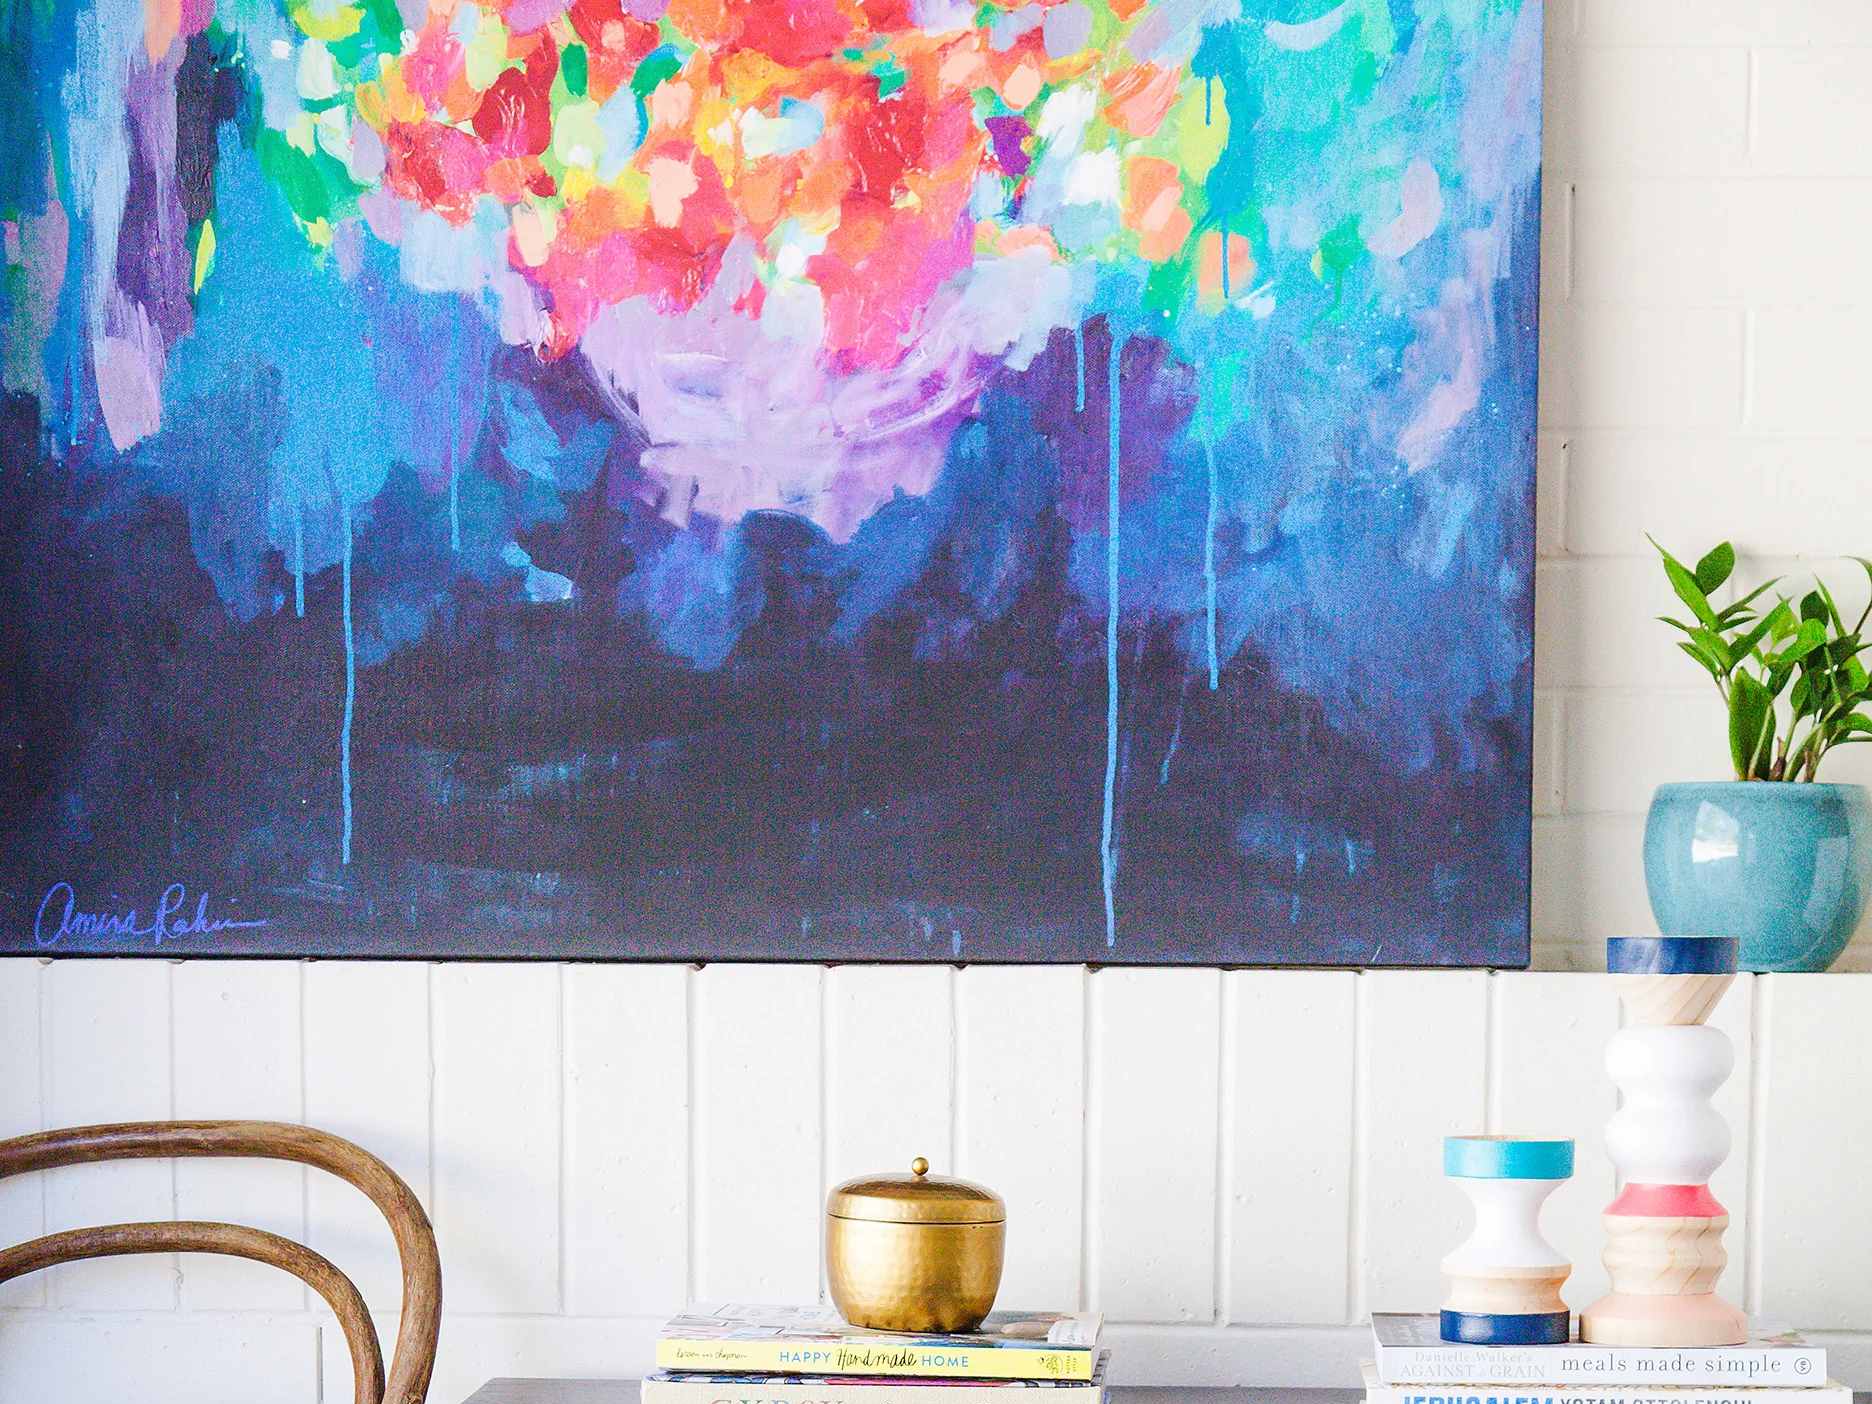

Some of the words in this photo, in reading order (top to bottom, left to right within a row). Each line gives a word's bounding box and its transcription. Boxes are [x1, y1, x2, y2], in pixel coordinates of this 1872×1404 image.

[779, 1351, 831, 1363] HAPPY
[836, 1348, 917, 1371] Handmade
[921, 1355, 969, 1367] HOME
[1415, 1352, 1470, 1362] Danielle
[1476, 1352, 1533, 1362] Walker's
[1561, 1353, 1627, 1372] meals
[1636, 1353, 1696, 1372] made
[1704, 1354, 1782, 1378] simple
[1400, 1364, 1475, 1378] AGAINST
[1489, 1365, 1546, 1378] GRAIN
